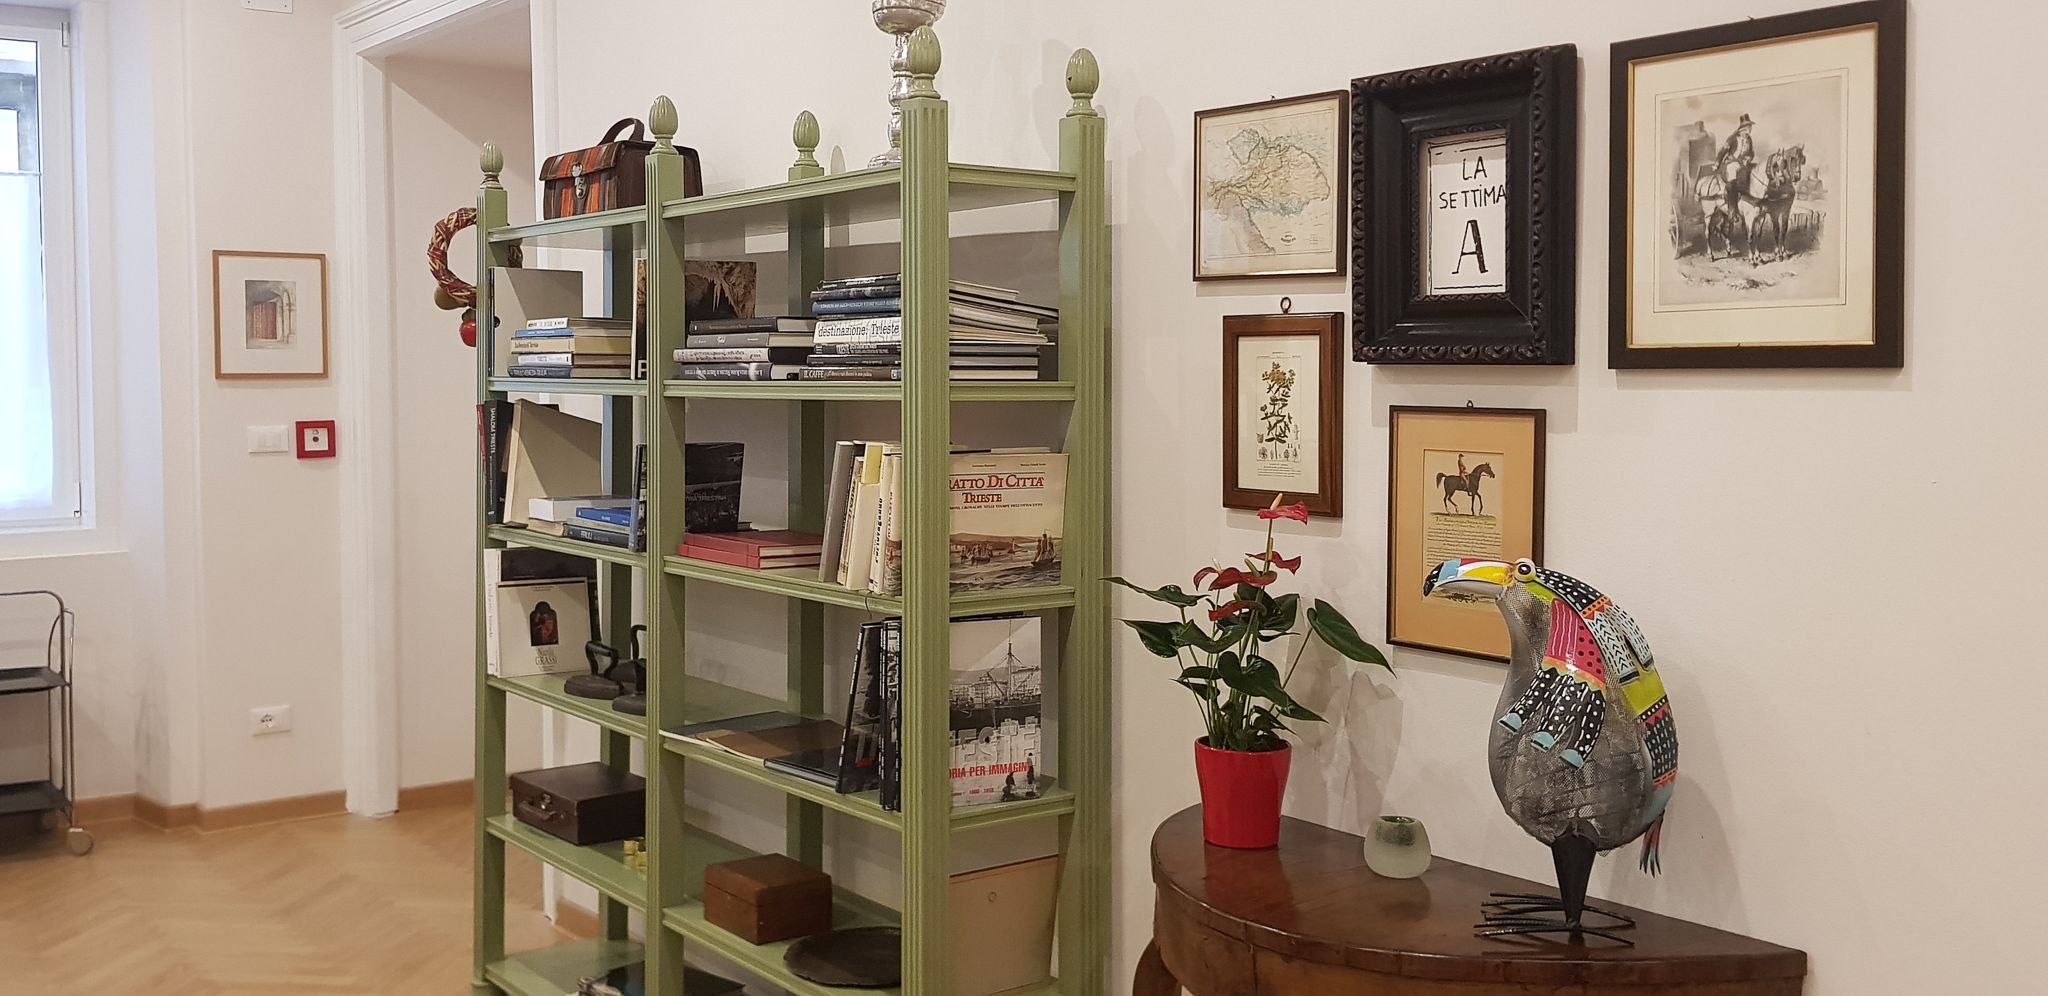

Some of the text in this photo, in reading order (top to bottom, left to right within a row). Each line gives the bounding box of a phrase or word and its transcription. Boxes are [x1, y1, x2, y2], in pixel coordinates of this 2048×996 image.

[1462, 156, 1487, 180] LA
[1439, 184, 1507, 209] SETTIMA
[1451, 219, 1489, 274] A
[818, 323, 900, 337] destinazione: Trieste
[969, 766, 986, 777] PER
